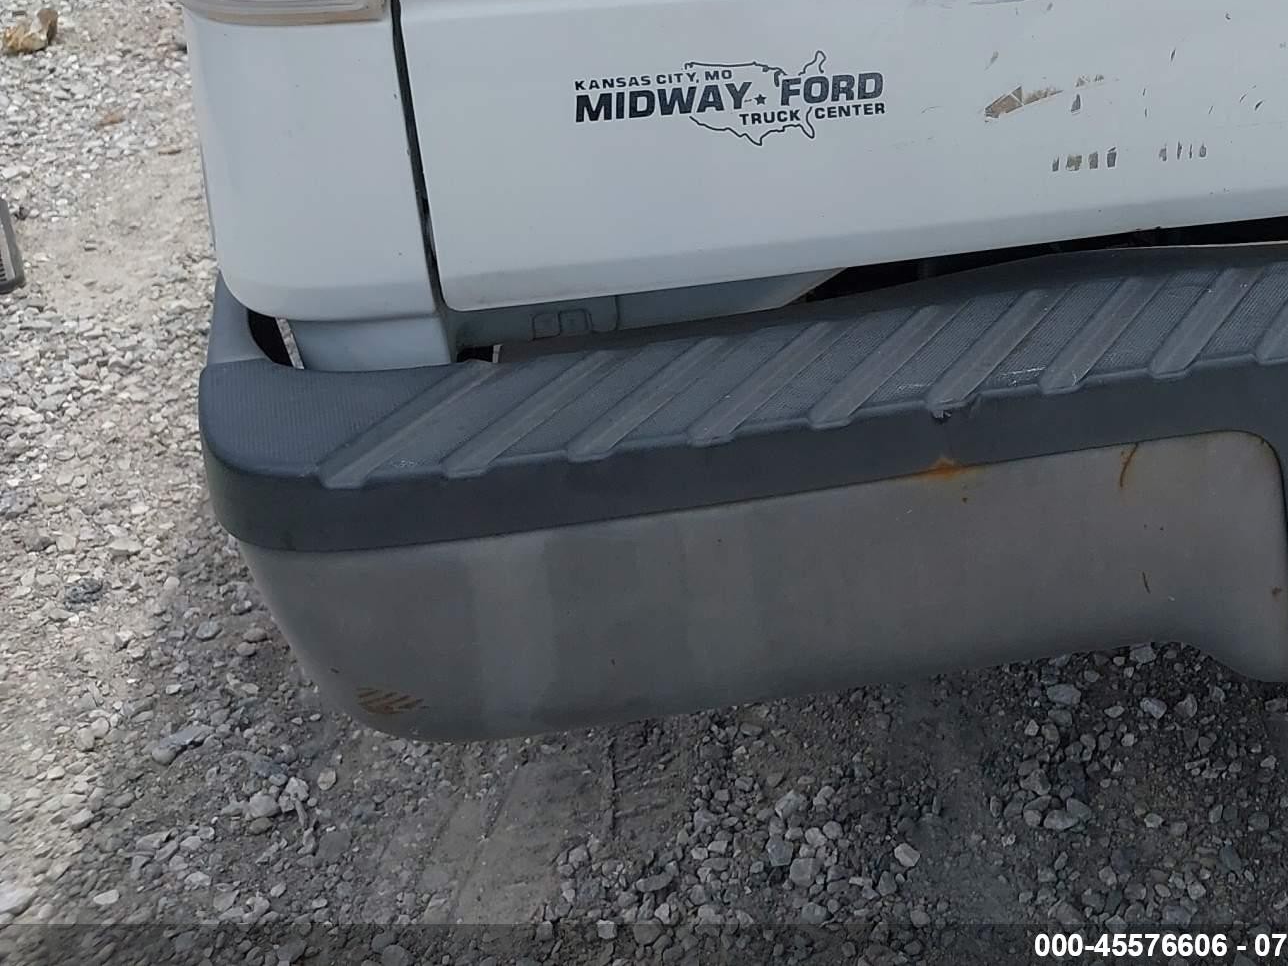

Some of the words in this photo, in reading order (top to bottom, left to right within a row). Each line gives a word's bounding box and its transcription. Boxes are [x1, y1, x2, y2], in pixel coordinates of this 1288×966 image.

[574, 75, 651, 91] KANSAS
[656, 71, 700, 85] CITY,
[704, 69, 733, 81] MO
[575, 81, 752, 123] MIDWAY
[780, 72, 884, 106] FORD
[739, 109, 801, 126] TRUCK
[814, 102, 886, 120] CENTER
